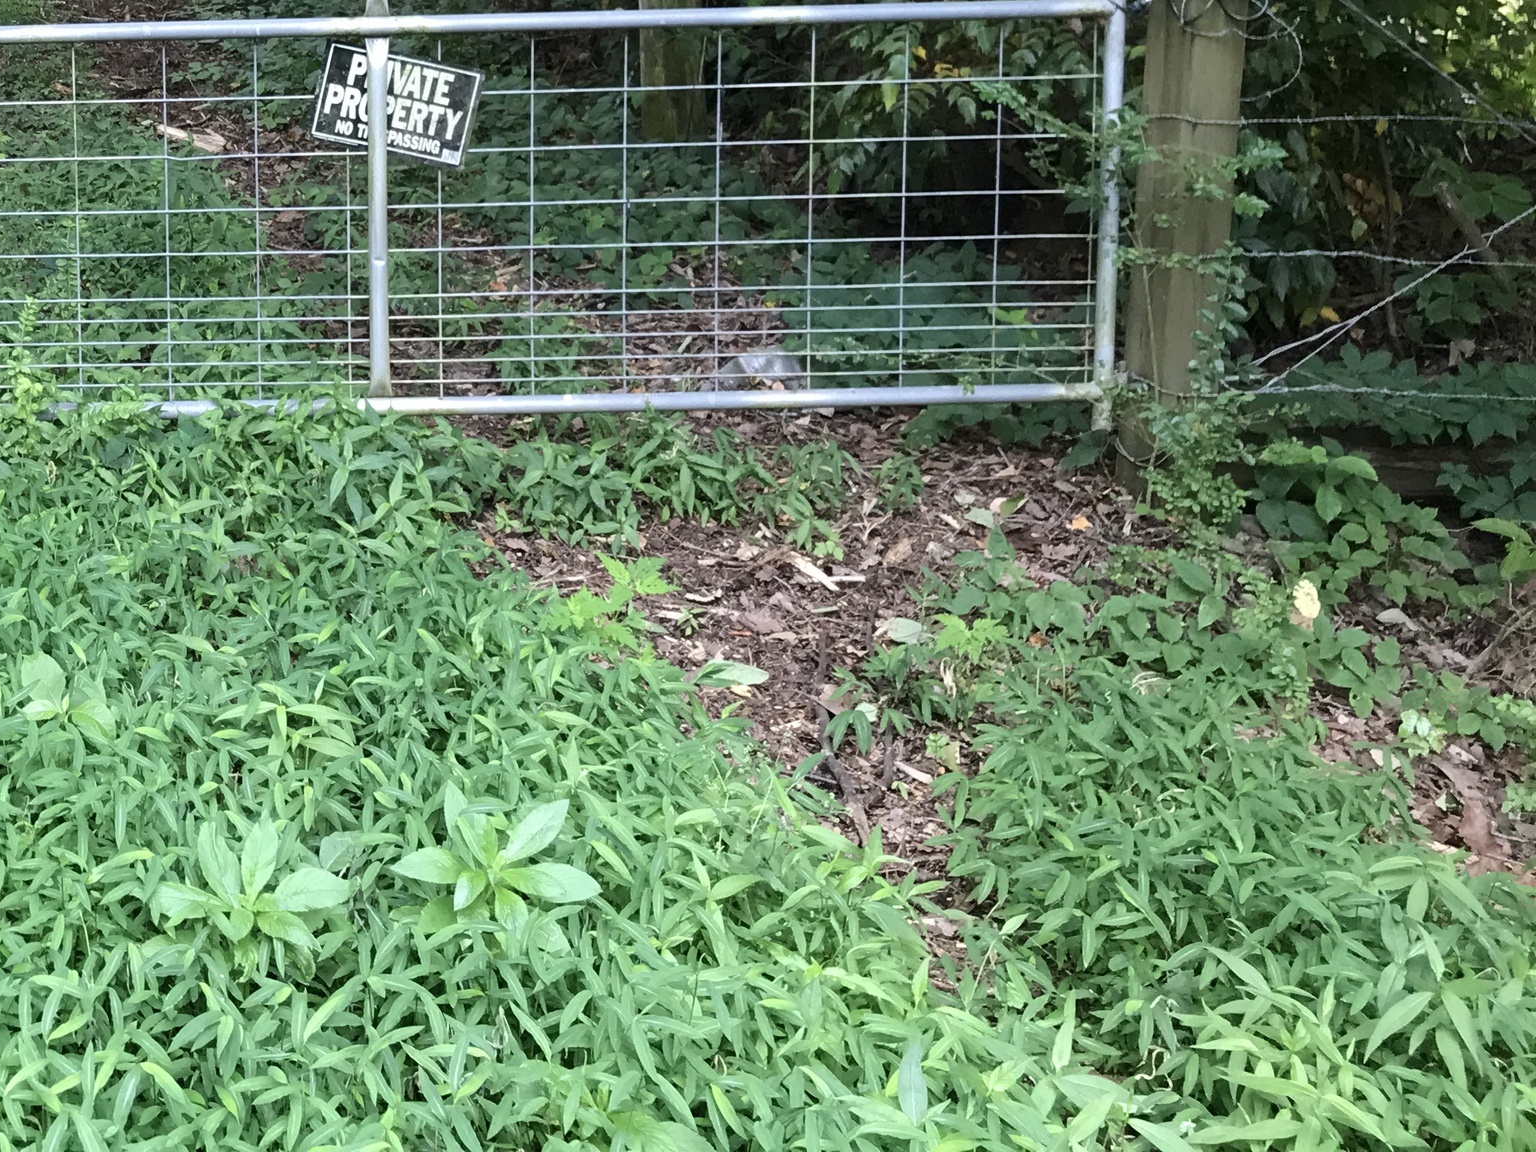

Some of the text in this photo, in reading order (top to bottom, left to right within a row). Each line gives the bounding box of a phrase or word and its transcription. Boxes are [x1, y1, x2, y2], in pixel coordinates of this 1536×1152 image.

[346, 53, 456, 106] PIVATE
[334, 119, 441, 155] NO TPASSING
